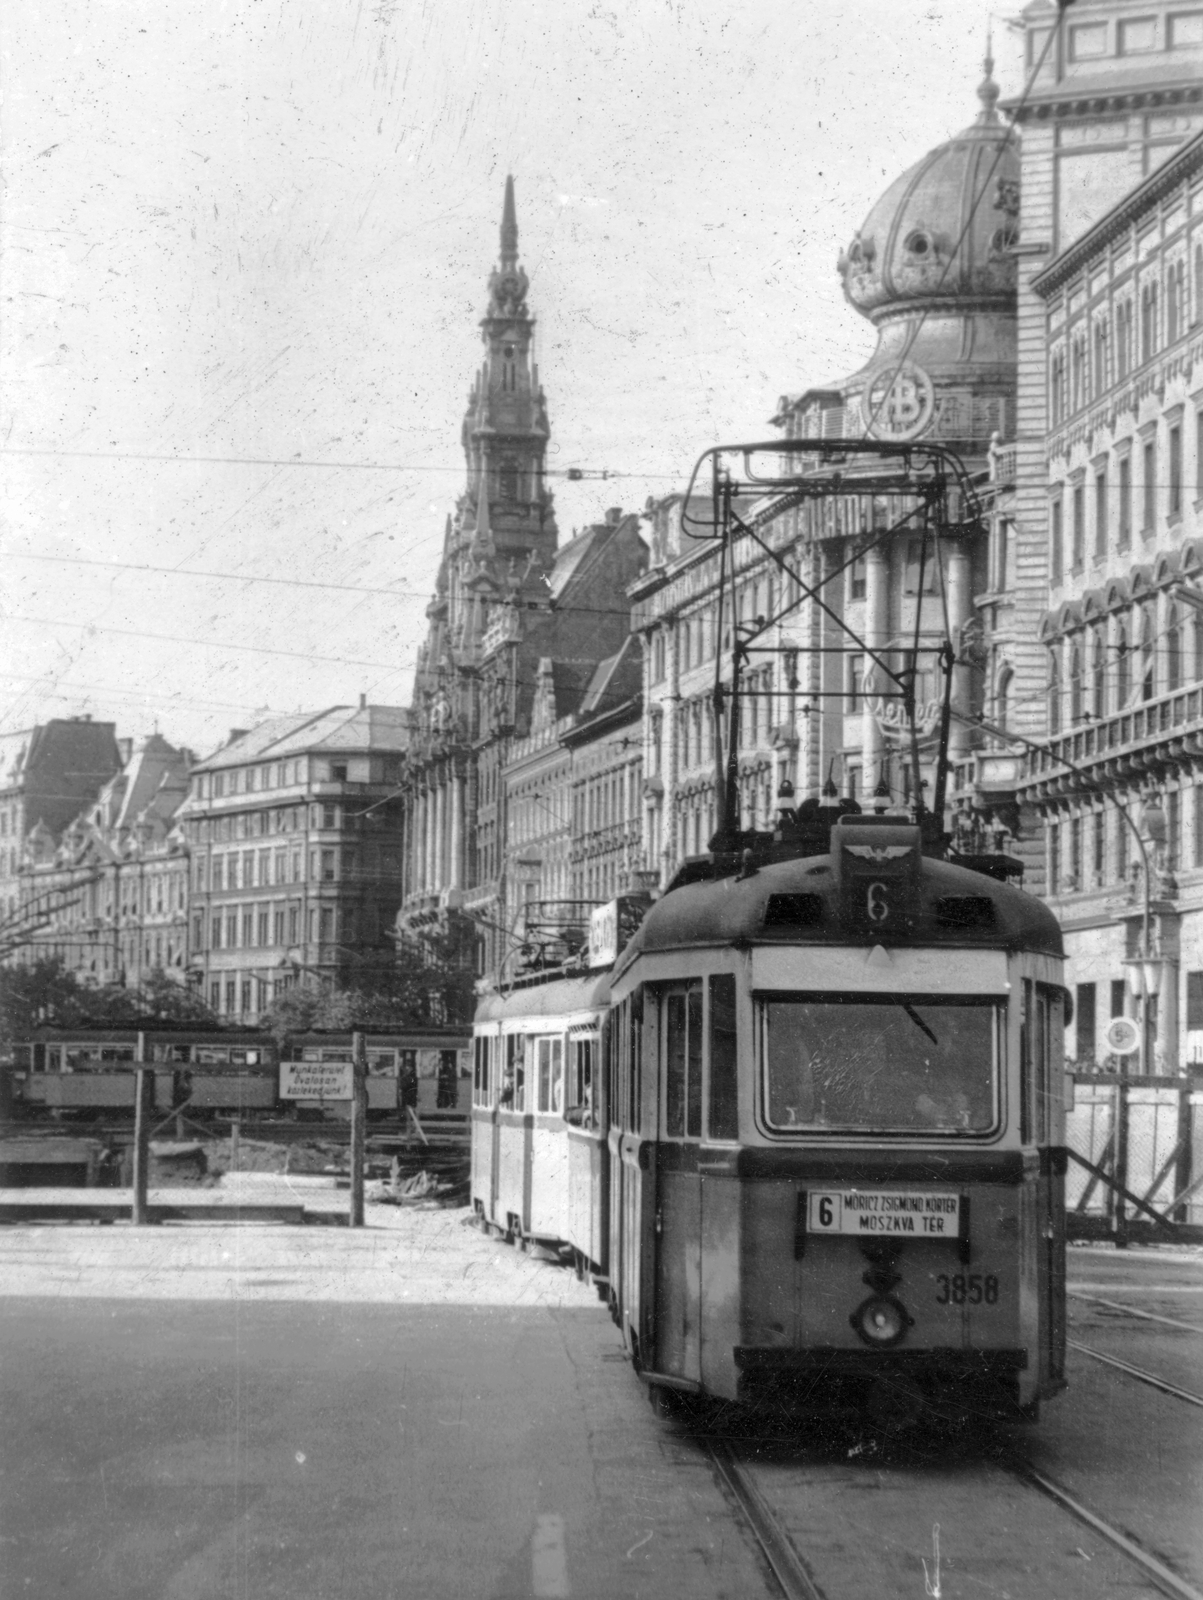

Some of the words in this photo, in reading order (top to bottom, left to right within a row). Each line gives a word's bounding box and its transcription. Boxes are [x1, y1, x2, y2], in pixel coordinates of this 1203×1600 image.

[867, 881, 889, 921] 6
[819, 1196, 833, 1227] 6
[881, 1196, 924, 1213] ZSIGMOND
[859, 1215, 915, 1232] MOSZKVA
[922, 1215, 945, 1233] TÉR
[936, 1273, 999, 1306] 3858
